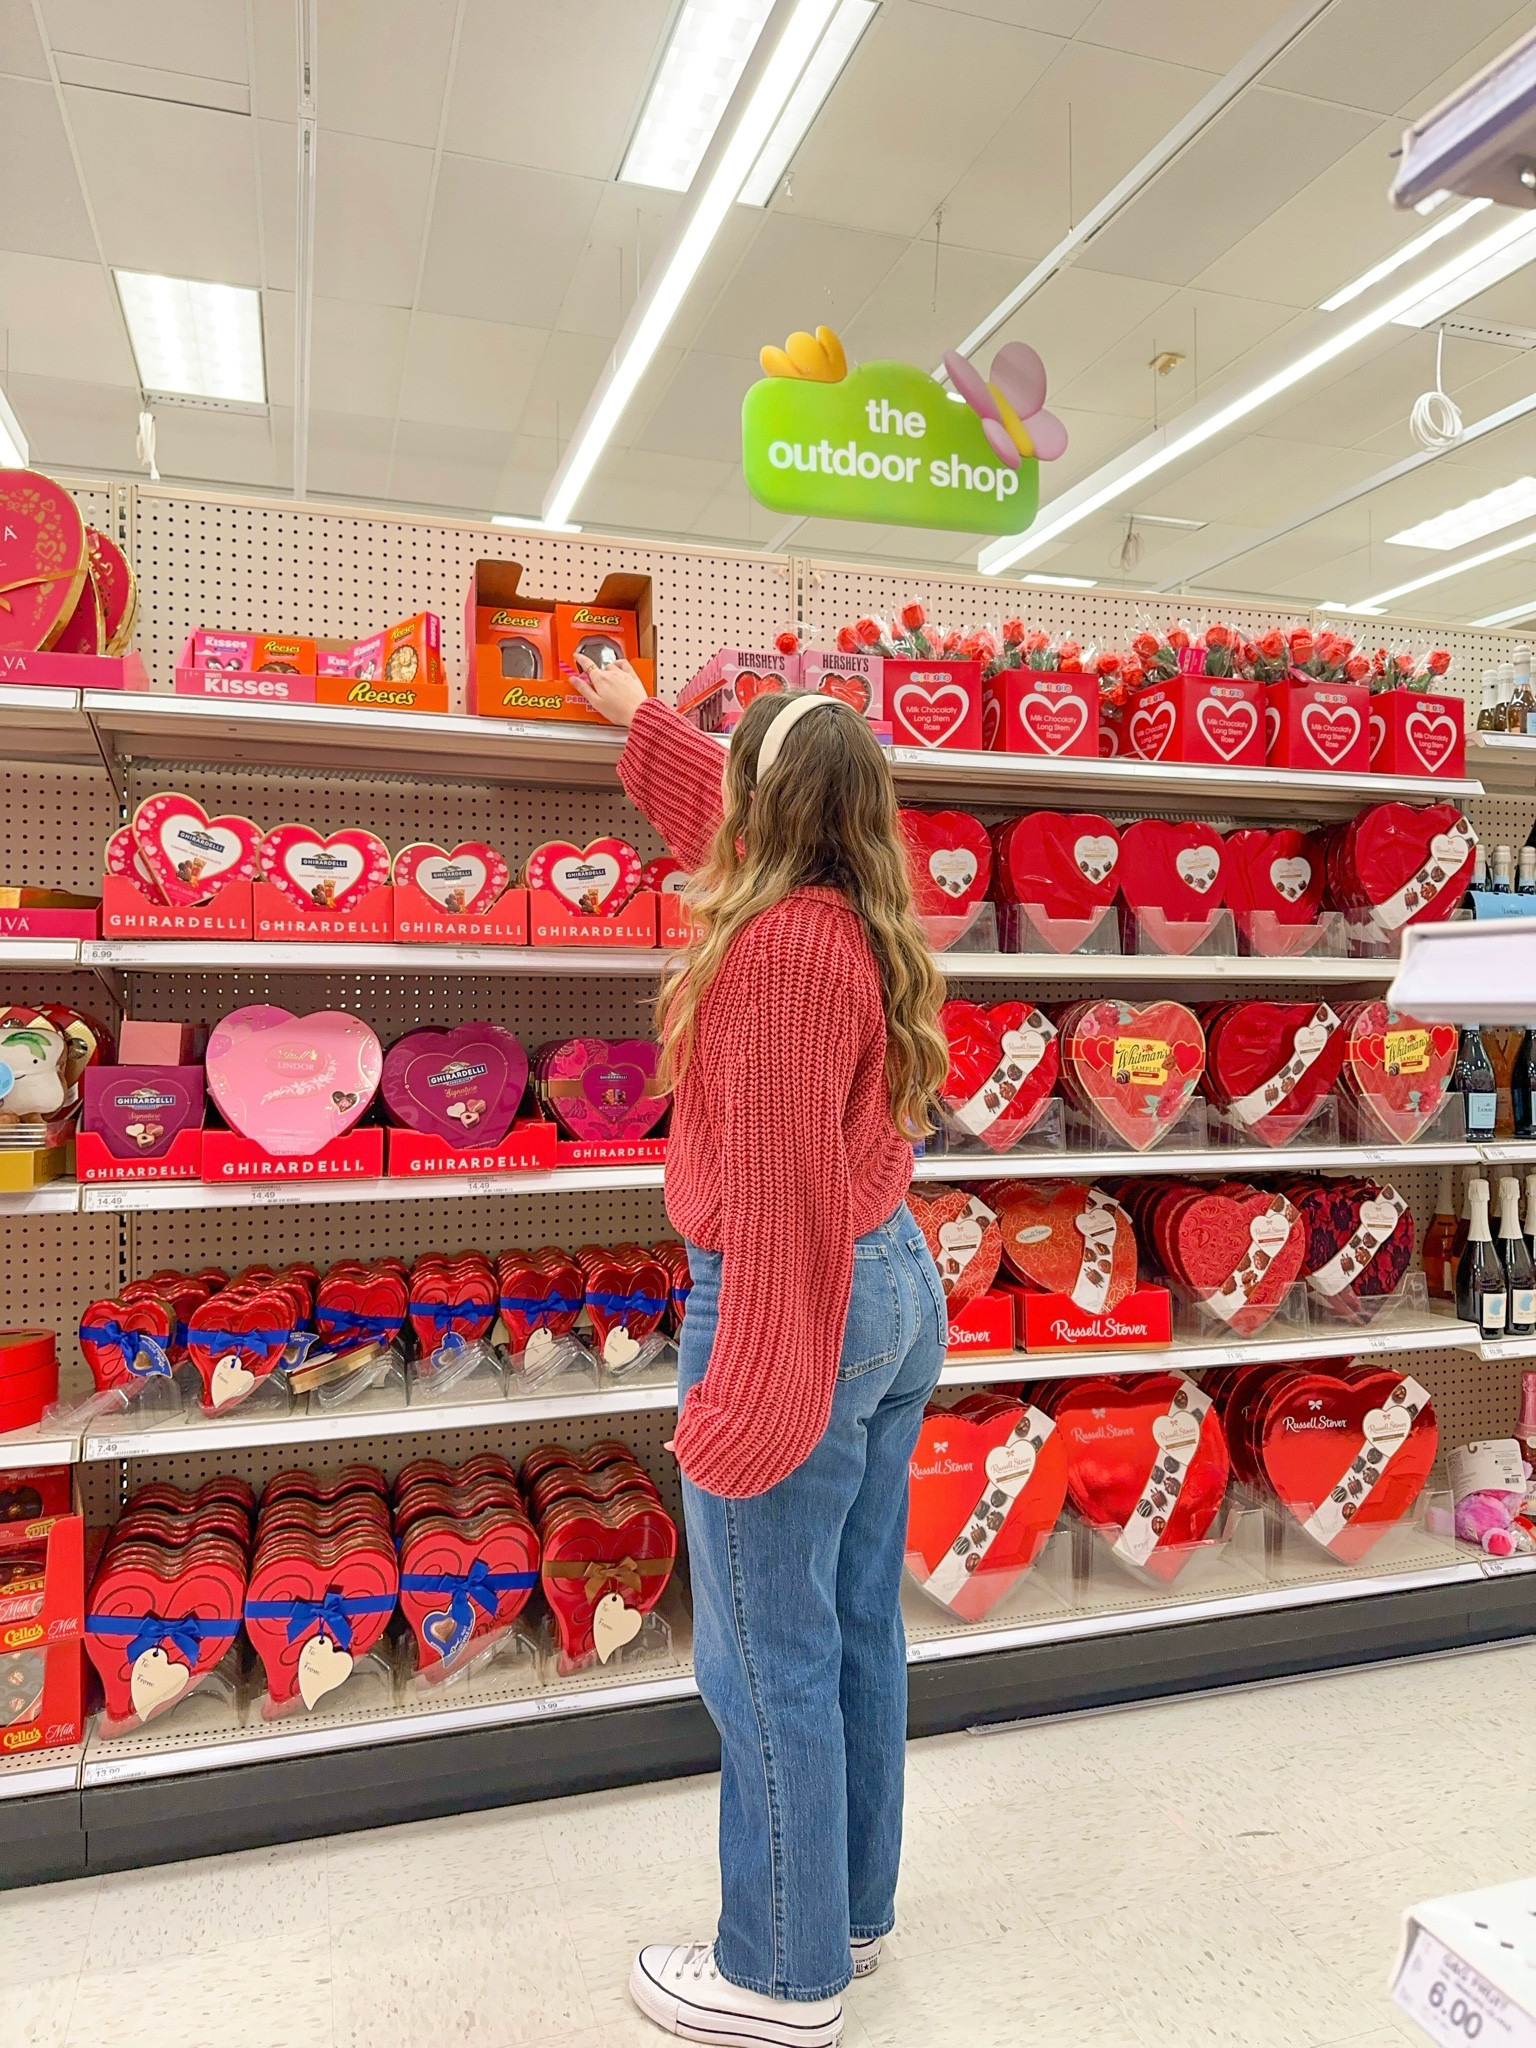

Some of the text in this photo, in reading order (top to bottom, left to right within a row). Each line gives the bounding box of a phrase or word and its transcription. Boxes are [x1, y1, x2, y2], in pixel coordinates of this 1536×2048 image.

[865, 399, 926, 438] the
[768, 439, 1019, 502] outdoor shop
[491, 610, 540, 628] Reese's
[572, 608, 621, 625] Reese's
[738, 652, 785, 671] HERSHEY'S
[822, 653, 869, 673] HERSHEY'S
[347, 681, 416, 705] Reese's
[502, 686, 563, 709] Reese's
[906, 705, 958, 717] Milk Chocolaty
[914, 715, 950, 725] Long Stem
[1030, 714, 1077, 724] Milk Chocolaty
[1207, 718, 1248, 729] Milk Chocolaty
[923, 723, 940, 731] Rose
[1037, 724, 1053, 732] Long
[1212, 727, 1243, 736] Long Stem
[1311, 723, 1352, 734] Milk Chocolaty
[1046, 731, 1061, 739] Rose
[1221, 735, 1235, 744] Rose
[1317, 732, 1346, 741] Long Stem
[1413, 732, 1424, 740] Milk
[1325, 740, 1339, 748] Rose
[1419, 741, 1431, 749] Long
[180, 832, 223, 851] GHIRARDELLI
[303, 859, 346, 867] GHIRARDELLI
[567, 870, 604, 878] GHIRARDELLI
[109, 914, 247, 930] GHIRARDELLI
[259, 920, 387, 934] GHIRARDELLI
[400, 921, 521, 936] GHIRARDELLI
[537, 926, 651, 937] GHIRARDELLI
[92, 950, 112, 959] 6.99
[1116, 1044, 1168, 1070] Whitman's
[277, 1062, 314, 1071] LINDOR
[1131, 1065, 1161, 1073] SAMPLER
[430, 1066, 485, 1084] GHIRARDELLI
[222, 1159, 364, 1175] GHIRARDELLI
[410, 1154, 540, 1172] GHIRARDELLI
[86, 1165, 195, 1179] GHIRARDELLI
[468, 1182, 491, 1190] 14.49
[97, 1197, 122, 1205] 14.49
[251, 1191, 276, 1199] 14.49
[947, 1325, 990, 1346] Stover
[1050, 1318, 1148, 1343] Russell Stover
[1283, 1415, 1347, 1432] Russell Stover
[1071, 1425, 1135, 1444] Russell Stover
[97, 1443, 118, 1453] 7.49
[908, 1460, 974, 1479] Russell Stover
[4, 1617, 79, 1646] Cella's Milk
[3, 1723, 75, 1749] Cella's Milk
[1428, 1980, 1484, 2040] 6.00
